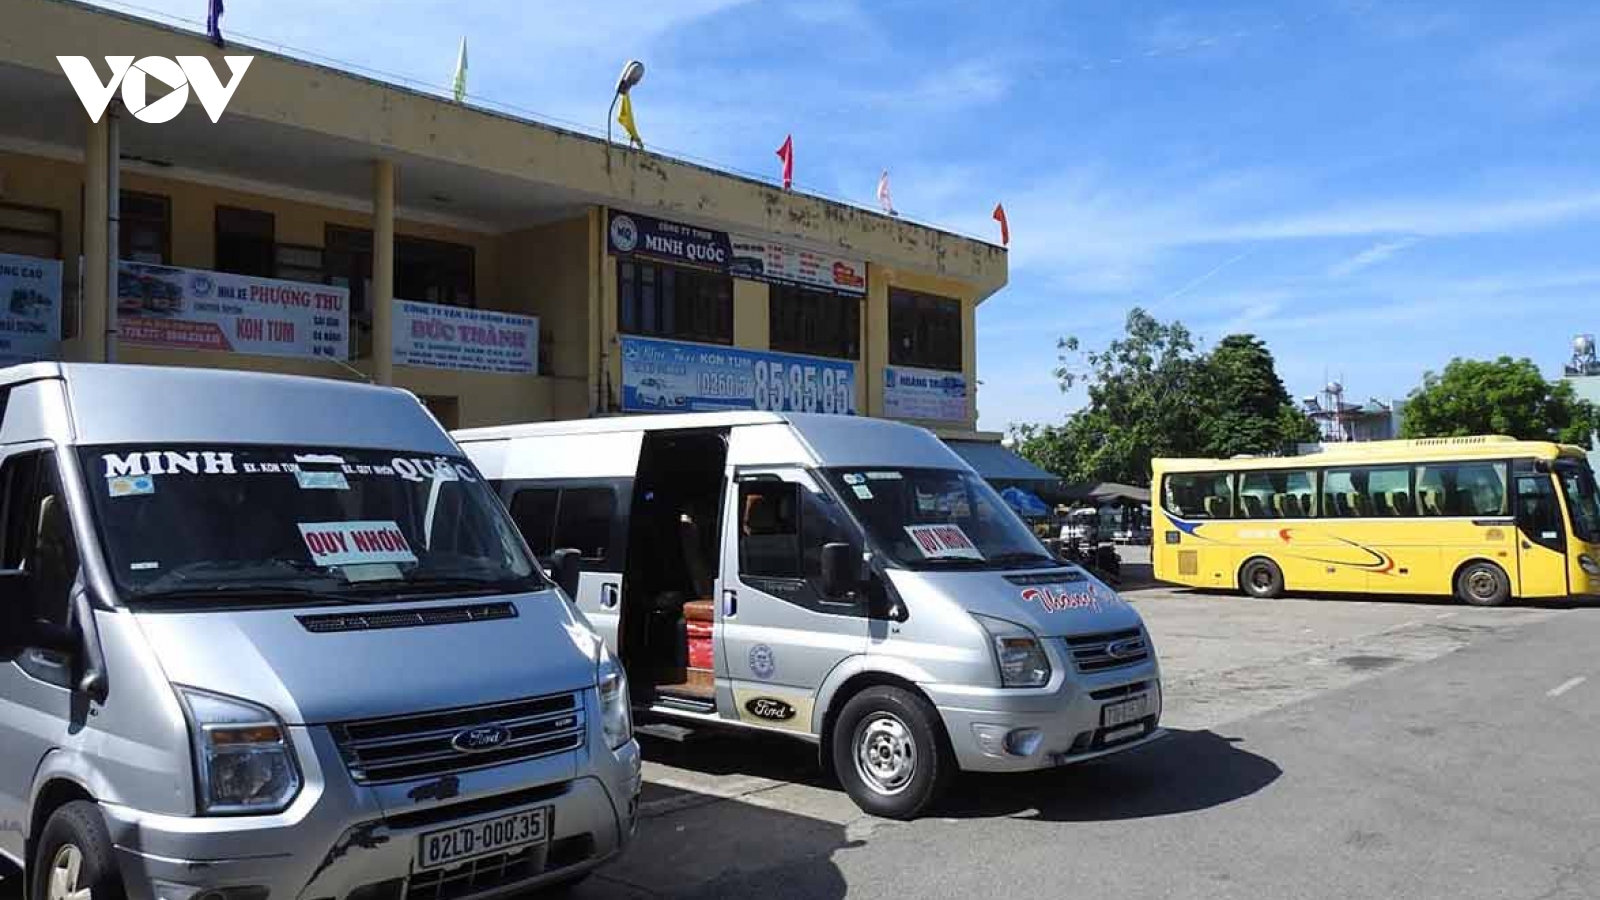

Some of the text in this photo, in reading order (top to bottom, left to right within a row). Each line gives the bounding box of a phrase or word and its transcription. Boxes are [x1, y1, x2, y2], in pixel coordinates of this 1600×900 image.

[644, 233, 683, 255] MINH
[686, 242, 725, 263] QUỐC
[313, 292, 344, 311] THU
[236, 317, 263, 342] KON
[266, 320, 296, 343] TUM
[102, 451, 238, 478] MINH
[306, 527, 409, 557] QUY NHƠN
[753, 699, 788, 720] Ford
[468, 728, 501, 747] Ford
[430, 812, 541, 862] 82LD-000.35
